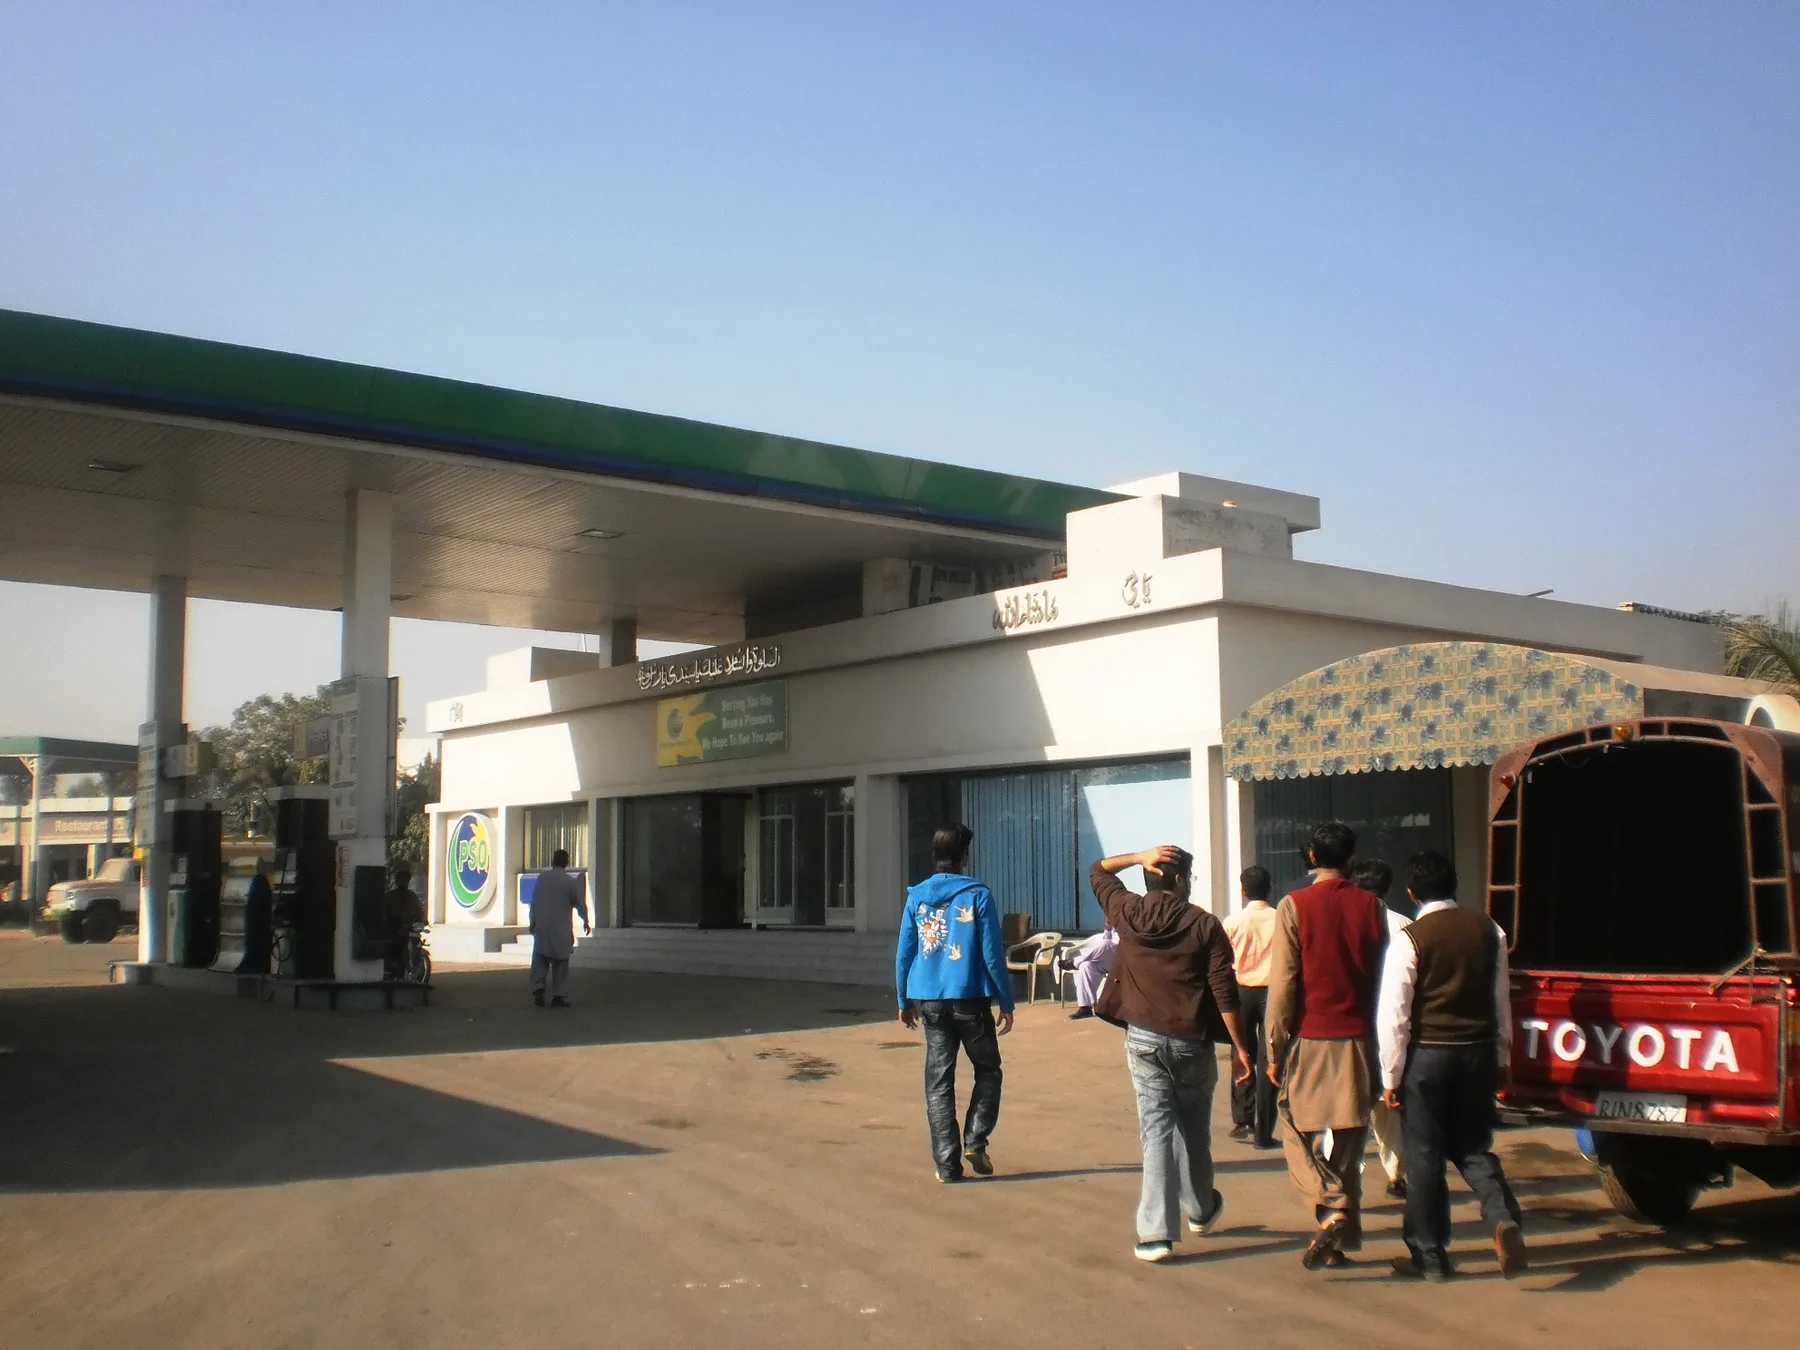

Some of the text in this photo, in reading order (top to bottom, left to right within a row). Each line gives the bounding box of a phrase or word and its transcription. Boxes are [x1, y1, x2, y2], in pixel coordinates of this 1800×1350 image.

[747, 695, 759, 708] You
[712, 736, 728, 750] Hope
[729, 734, 737, 746] To
[738, 732, 750, 745] See
[751, 731, 763, 744] You
[458, 839, 487, 873] PSO
[1522, 1019, 1740, 1073] TOYOTA
